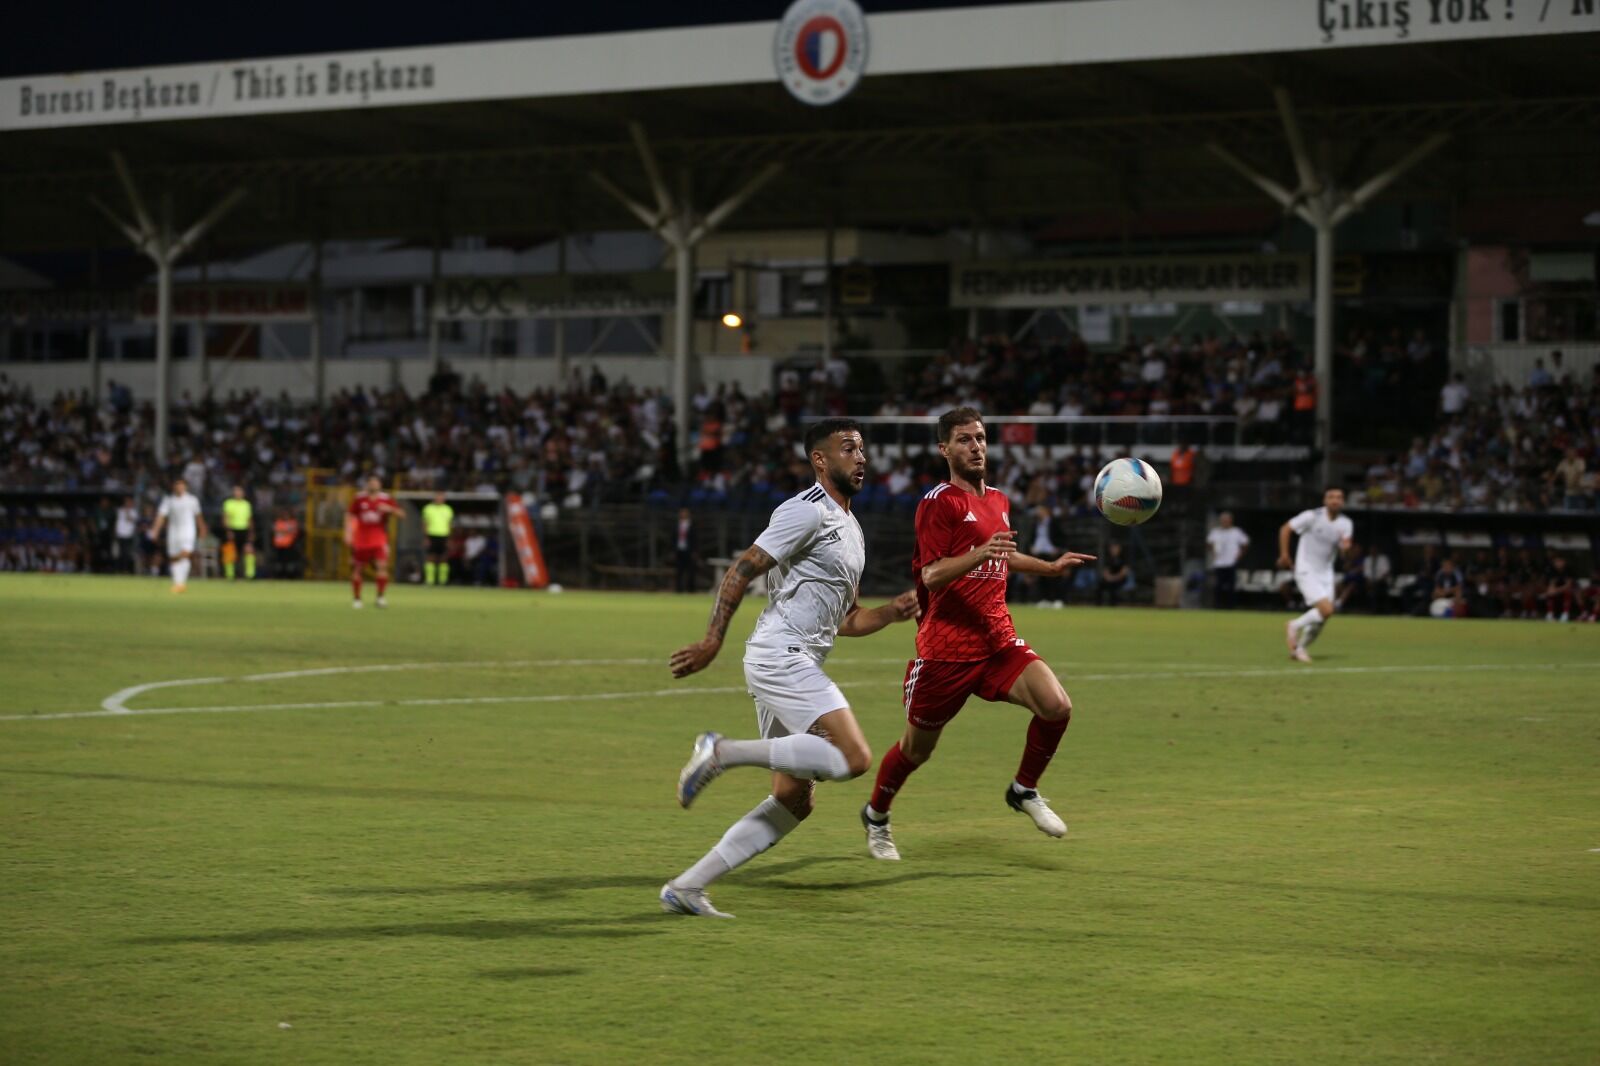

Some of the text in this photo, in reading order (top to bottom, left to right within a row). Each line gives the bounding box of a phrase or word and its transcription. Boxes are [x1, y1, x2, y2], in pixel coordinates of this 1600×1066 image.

[1317, 0, 1411, 43] Çıkış
[20, 85, 94, 117] Burası
[103, 76, 200, 118] Beşkaza
[233, 65, 286, 101] This
[296, 63, 318, 97] is
[327, 58, 435, 104] Beşkaza
[446, 278, 521, 315] DOC
